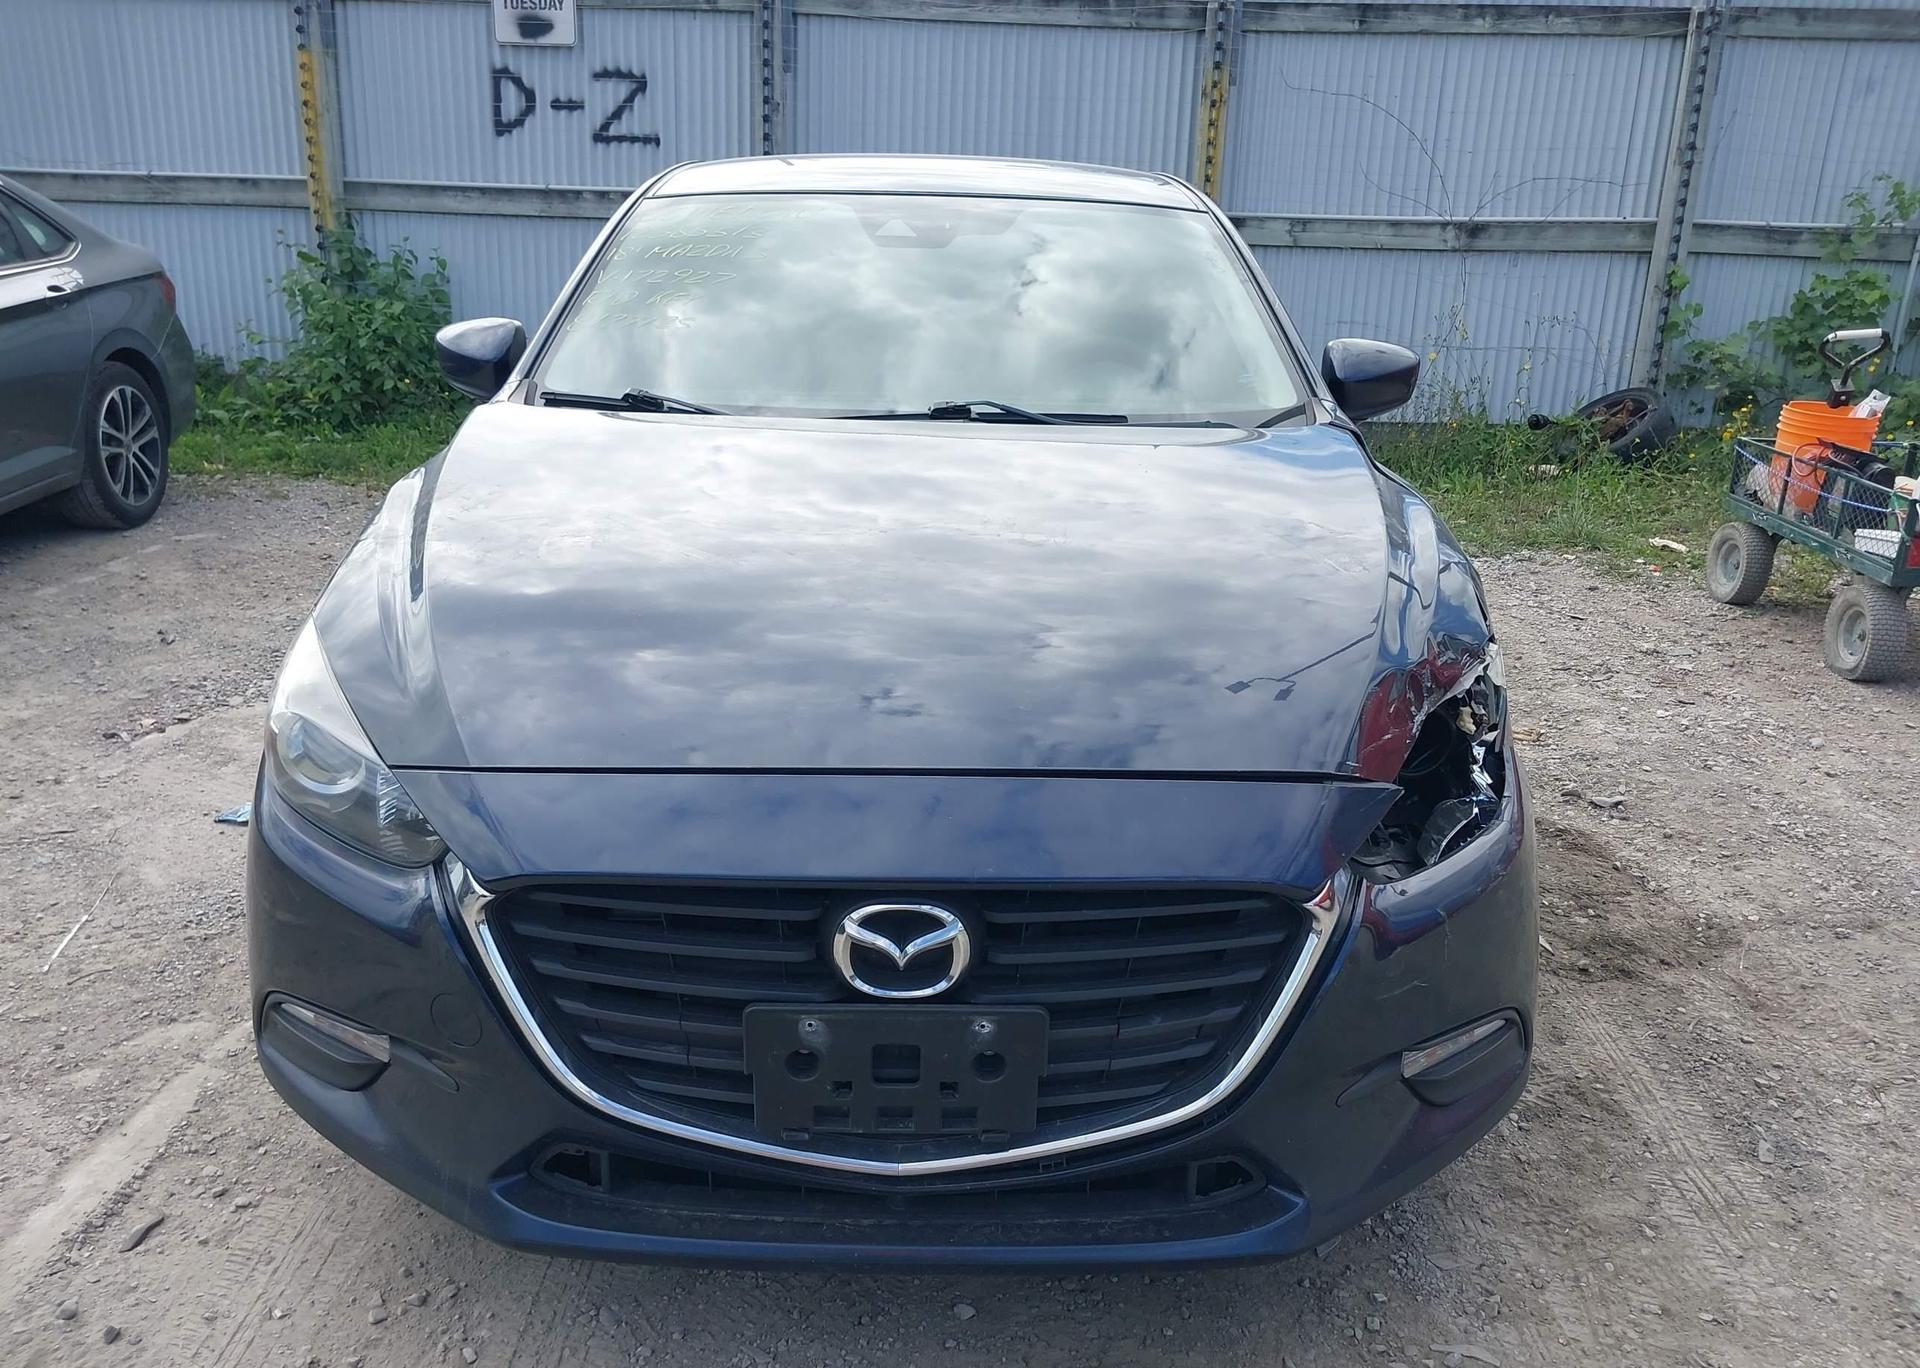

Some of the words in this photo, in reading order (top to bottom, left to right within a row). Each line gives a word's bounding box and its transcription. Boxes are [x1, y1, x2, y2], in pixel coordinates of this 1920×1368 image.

[503, 0, 565, 11] TUESDAY
[491, 66, 661, 148] D-Z
[644, 242, 744, 259] MAZDA
